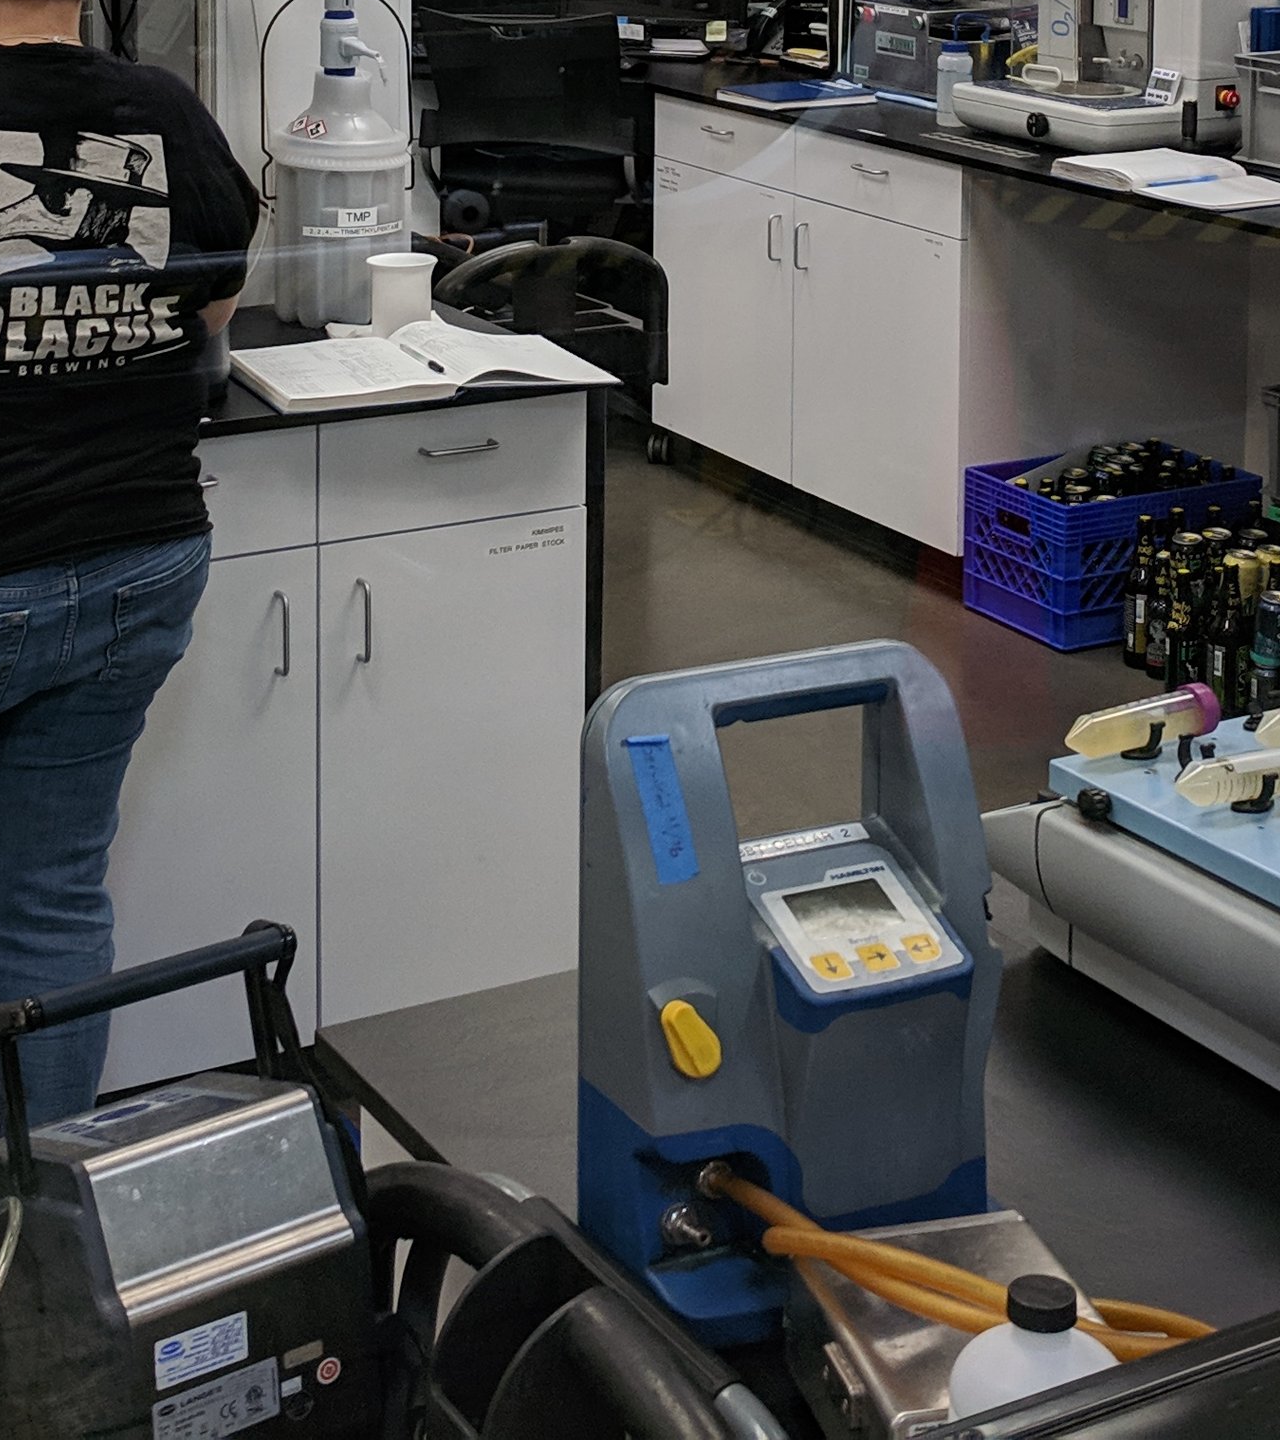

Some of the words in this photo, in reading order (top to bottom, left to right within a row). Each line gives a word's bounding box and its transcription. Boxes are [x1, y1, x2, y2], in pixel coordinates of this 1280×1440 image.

[346, 211, 371, 223] TMP
[9, 282, 150, 317] BLACK
[17, 356, 127, 377] BREWING
[488, 545, 512, 555] FILTER
[516, 541, 538, 551] PAPER
[542, 538, 565, 548] STOCK
[774, 832, 834, 851] CELLAR
[840, 828, 851, 838] 2
[829, 865, 886, 881] HAMILTON
